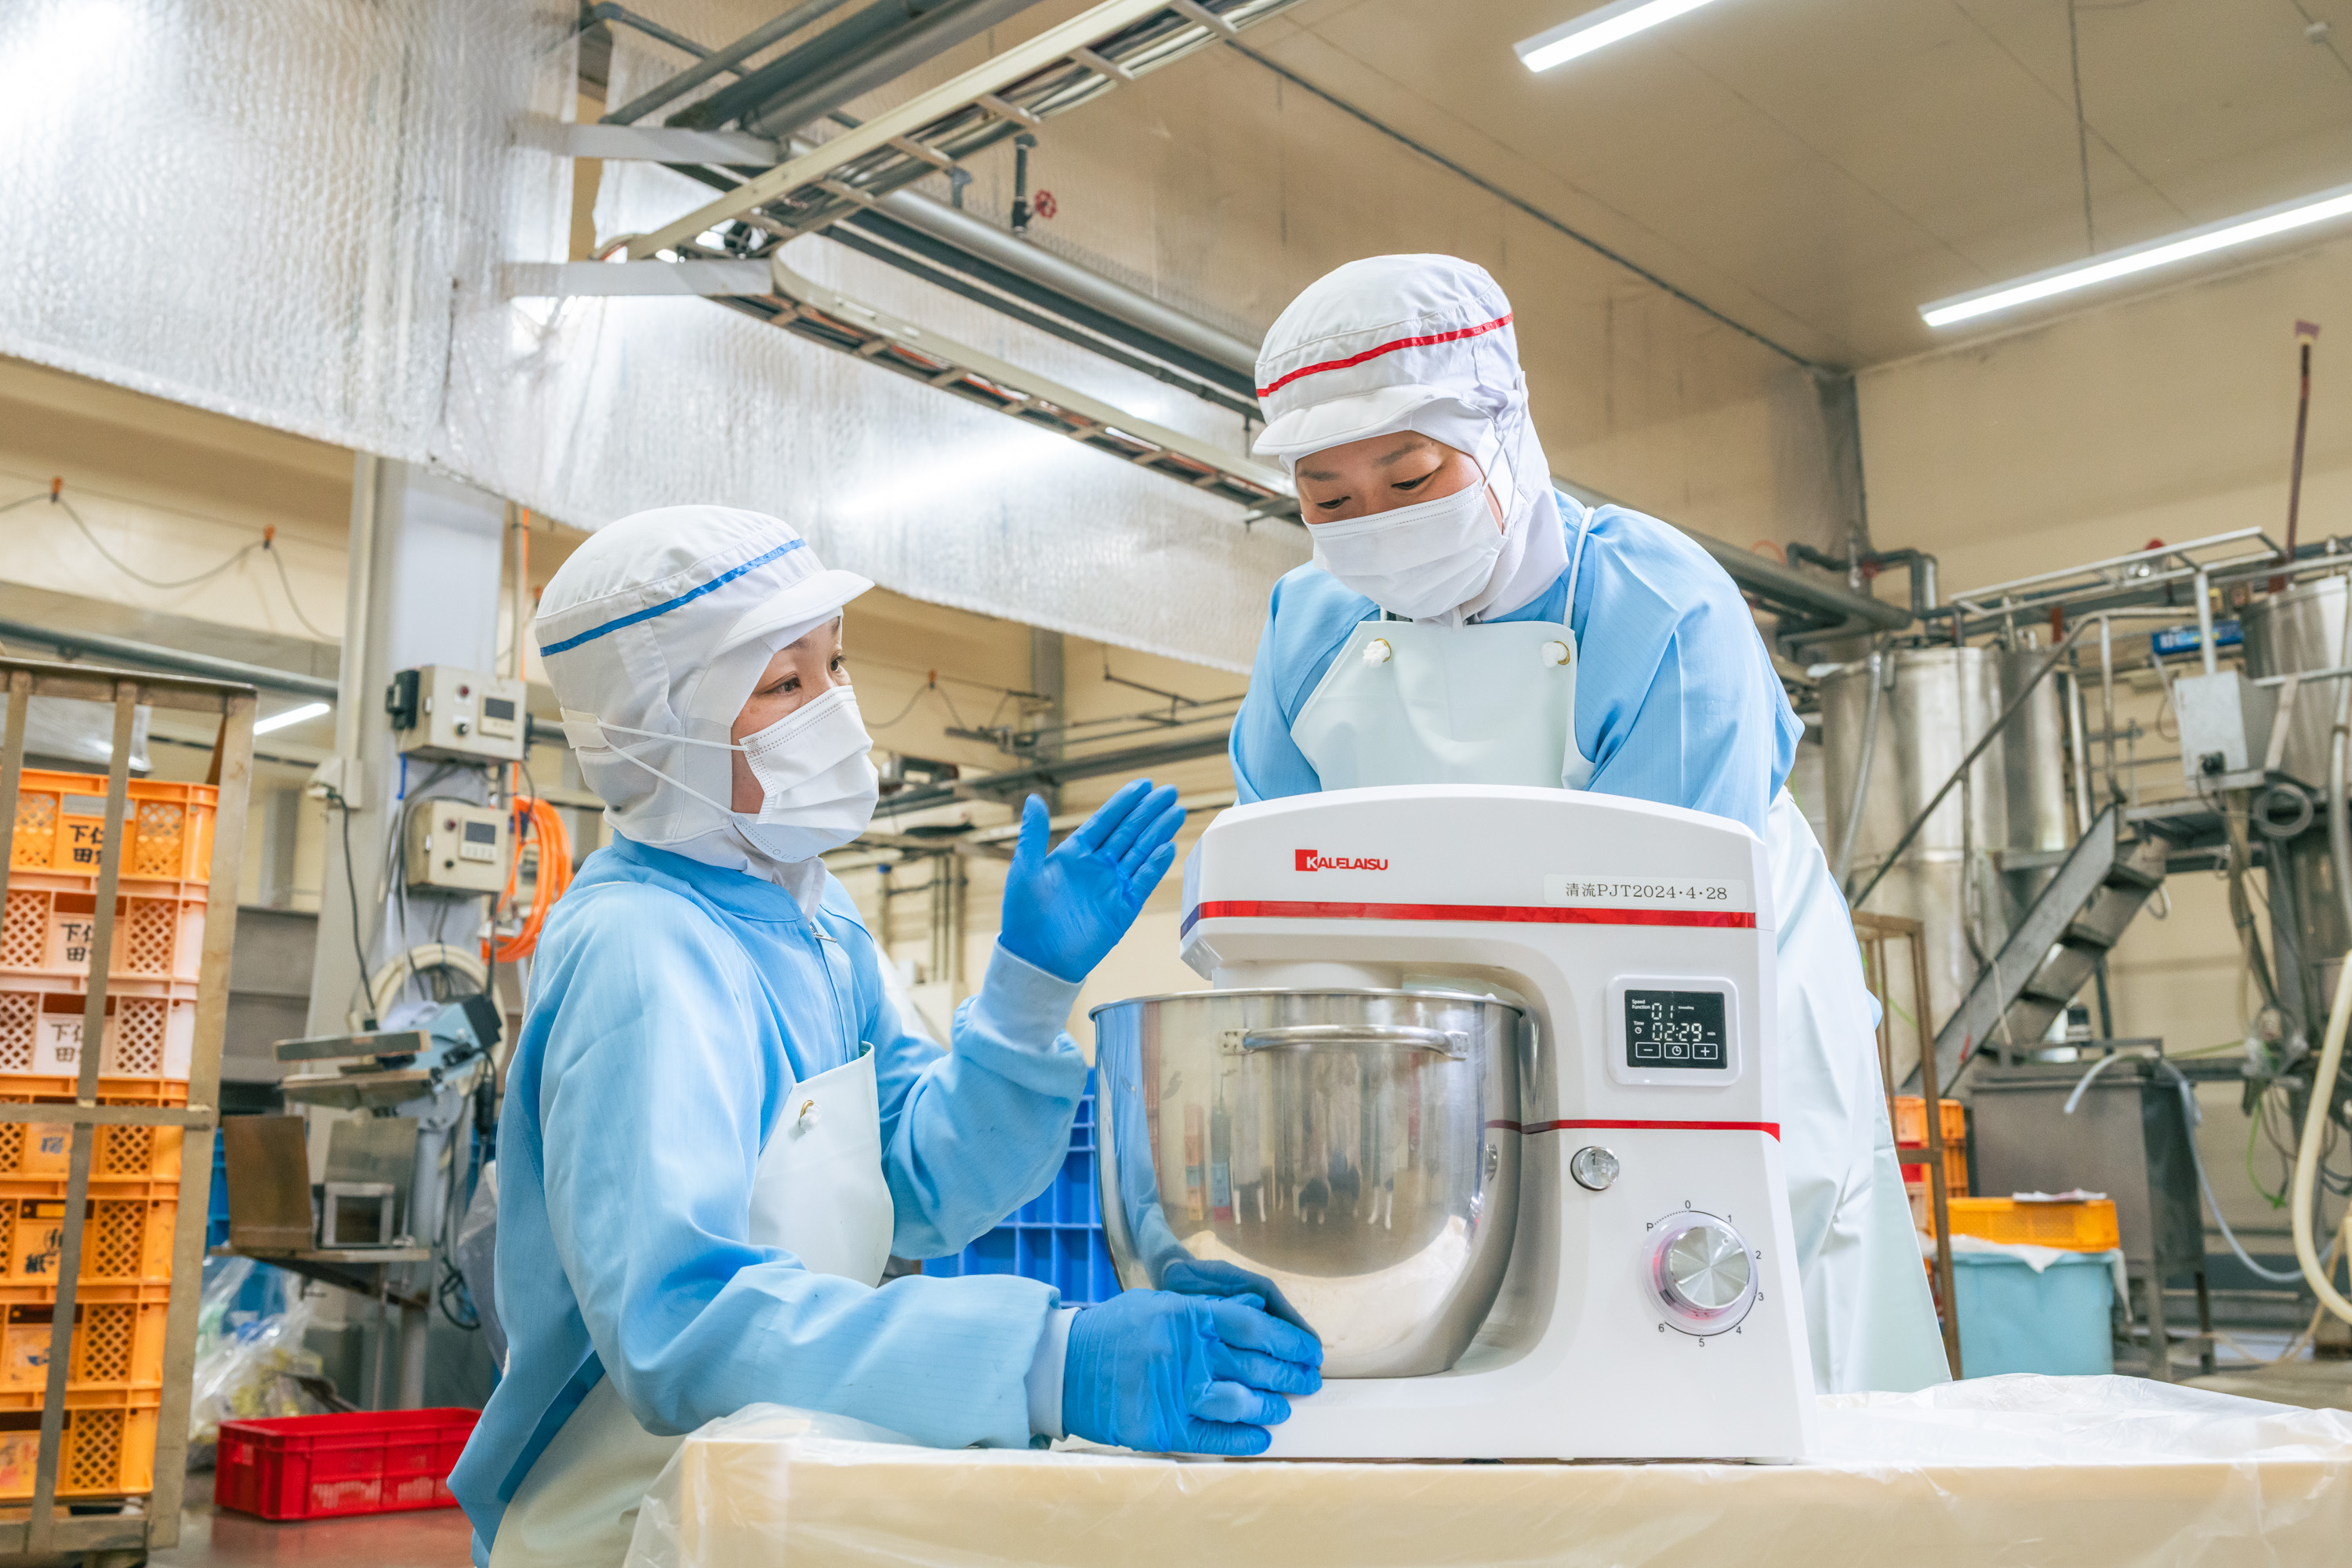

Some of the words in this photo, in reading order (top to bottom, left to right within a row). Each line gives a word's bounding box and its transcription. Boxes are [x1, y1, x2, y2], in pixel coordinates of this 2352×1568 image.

[1306, 855, 1388, 871] KALELAISU
[1652, 1022, 1702, 1042] 02:29
[1685, 1200, 1691, 1209] 0
[1646, 1222, 1653, 1232] P
[1755, 1250, 1762, 1260] 2
[1758, 1292, 1764, 1301] 3
[1658, 1323, 1664, 1333] 6
[1736, 1326, 1742, 1334] 4
[1699, 1338, 1705, 1348] 5
